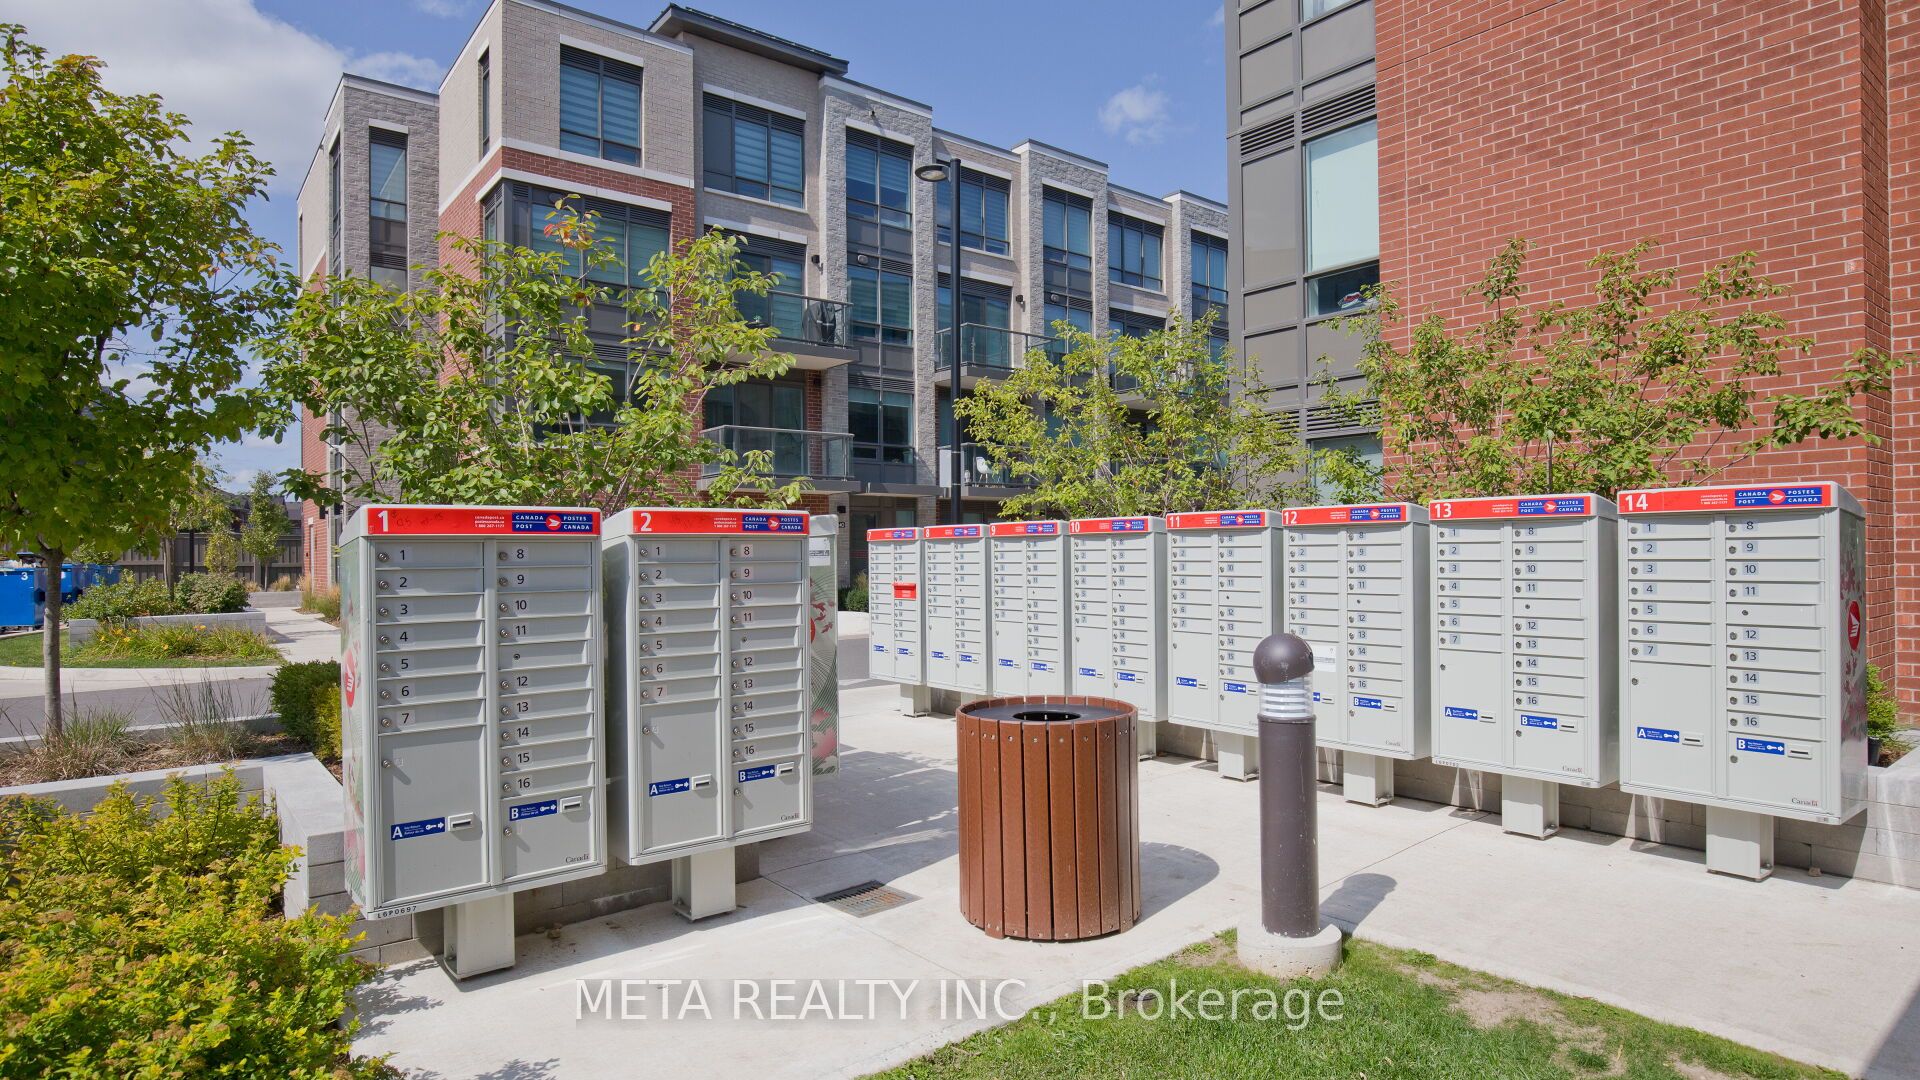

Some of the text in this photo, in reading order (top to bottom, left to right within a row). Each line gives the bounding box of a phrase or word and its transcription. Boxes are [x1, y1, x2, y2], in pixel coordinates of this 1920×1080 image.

[1625, 494, 1648, 511] 14
[1435, 503, 1451, 518] 13
[377, 511, 389, 532] 1
[640, 512, 652, 532] 2
[1169, 515, 1180, 527] 11
[1284, 512, 1298, 524] 12
[1071, 521, 1080, 533] 10
[1746, 521, 1754, 530] 8
[992, 527, 996, 535] 9
[1528, 527, 1534, 535] 8
[744, 546, 750, 555] 8
[1451, 546, 1457, 554] 2
[1528, 546, 1534, 554] 9
[1647, 544, 1653, 552] 2
[1746, 543, 1754, 552] 9
[516, 549, 524, 559] 8
[744, 568, 750, 578] 9
[1527, 565, 1536, 573] 10
[1647, 564, 1653, 573] 3
[1745, 565, 1757, 574] 10
[21, 572, 28, 580] 3
[655, 569, 662, 579] 2
[399, 577, 407, 588] 2
[517, 574, 524, 584] 9
[743, 590, 752, 600] 10
[1745, 586, 1755, 595] 11
[656, 593, 662, 603] 3
[515, 600, 527, 610] 10
[1452, 600, 1458, 608] 5
[400, 604, 408, 615] 3
[1647, 605, 1653, 614] 5
[655, 617, 662, 626] 4
[744, 613, 751, 621] 11
[1452, 617, 1458, 626] 6
[1528, 621, 1536, 629] 12
[1647, 625, 1654, 634] 6
[516, 625, 526, 635] 11
[1358, 630, 1366, 639] 13
[1746, 630, 1756, 639] 12
[400, 631, 408, 642] 4
[1452, 635, 1458, 643] 7
[656, 640, 662, 650] 5
[1527, 640, 1537, 648] 13
[1648, 646, 1654, 654] 7
[1745, 651, 1757, 660] 13
[401, 658, 409, 669] 5
[744, 657, 753, 666] 12
[656, 663, 663, 673] 6
[1359, 664, 1367, 672] 15
[516, 676, 528, 686] 12
[1528, 677, 1537, 686] 15
[1745, 673, 1757, 682] 14
[744, 679, 753, 688] 13
[401, 686, 410, 697] 6
[657, 687, 663, 697] 7
[1528, 696, 1538, 705] 16
[1745, 695, 1757, 704] 15
[517, 702, 529, 712] 13
[744, 701, 753, 710] 14
[402, 713, 409, 724] 7
[1522, 717, 1528, 725] B
[1745, 717, 1758, 726] 16
[745, 723, 754, 732] 15
[517, 727, 529, 738] 14
[1638, 729, 1646, 738] A
[1738, 740, 1745, 749] B
[745, 745, 755, 755] 16
[518, 752, 530, 763] 15
[740, 771, 746, 782] B
[518, 777, 530, 789] 16
[650, 784, 658, 796] A
[1792, 798, 1818, 807] Canada
[511, 808, 519, 819] B
[780, 812, 800, 821] Canada
[392, 826, 403, 838] A
[565, 853, 589, 863] Canada
